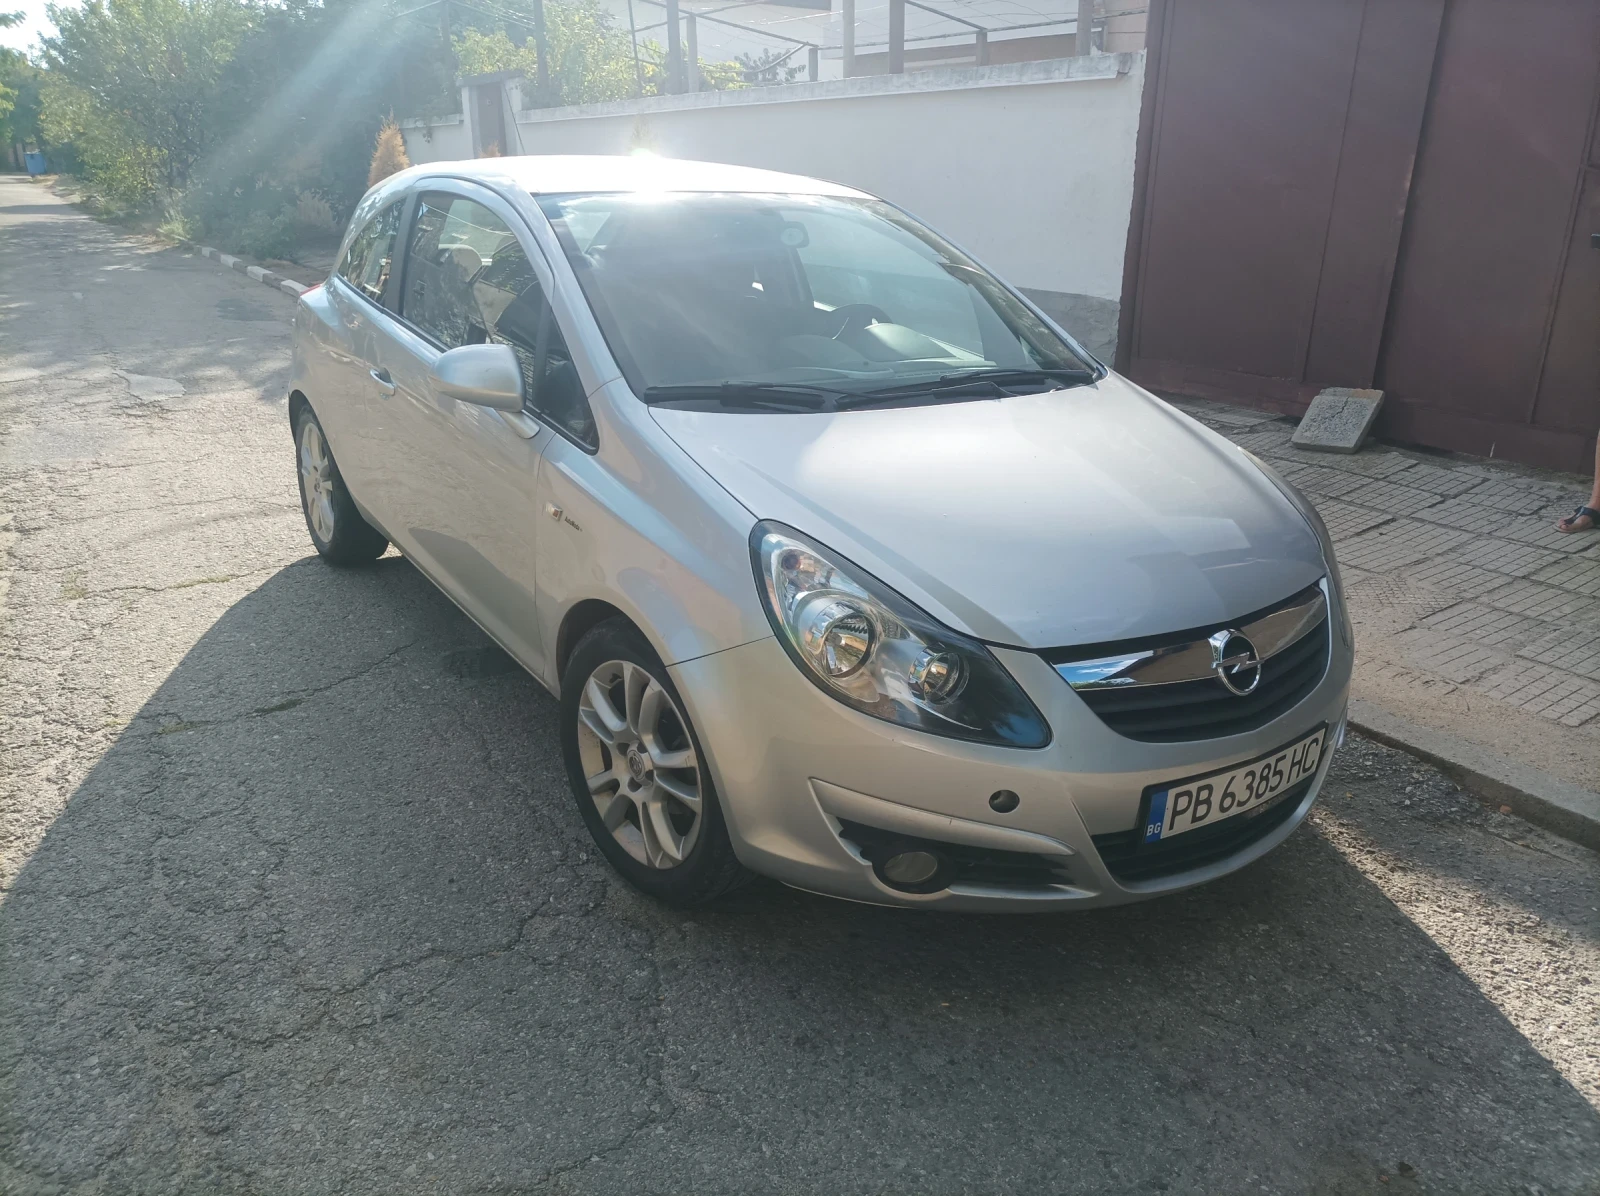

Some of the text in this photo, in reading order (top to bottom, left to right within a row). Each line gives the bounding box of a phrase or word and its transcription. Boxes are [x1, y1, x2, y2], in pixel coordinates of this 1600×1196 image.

[1168, 737, 1319, 831] PB 6385 HC
[1146, 822, 1162, 836] BG
